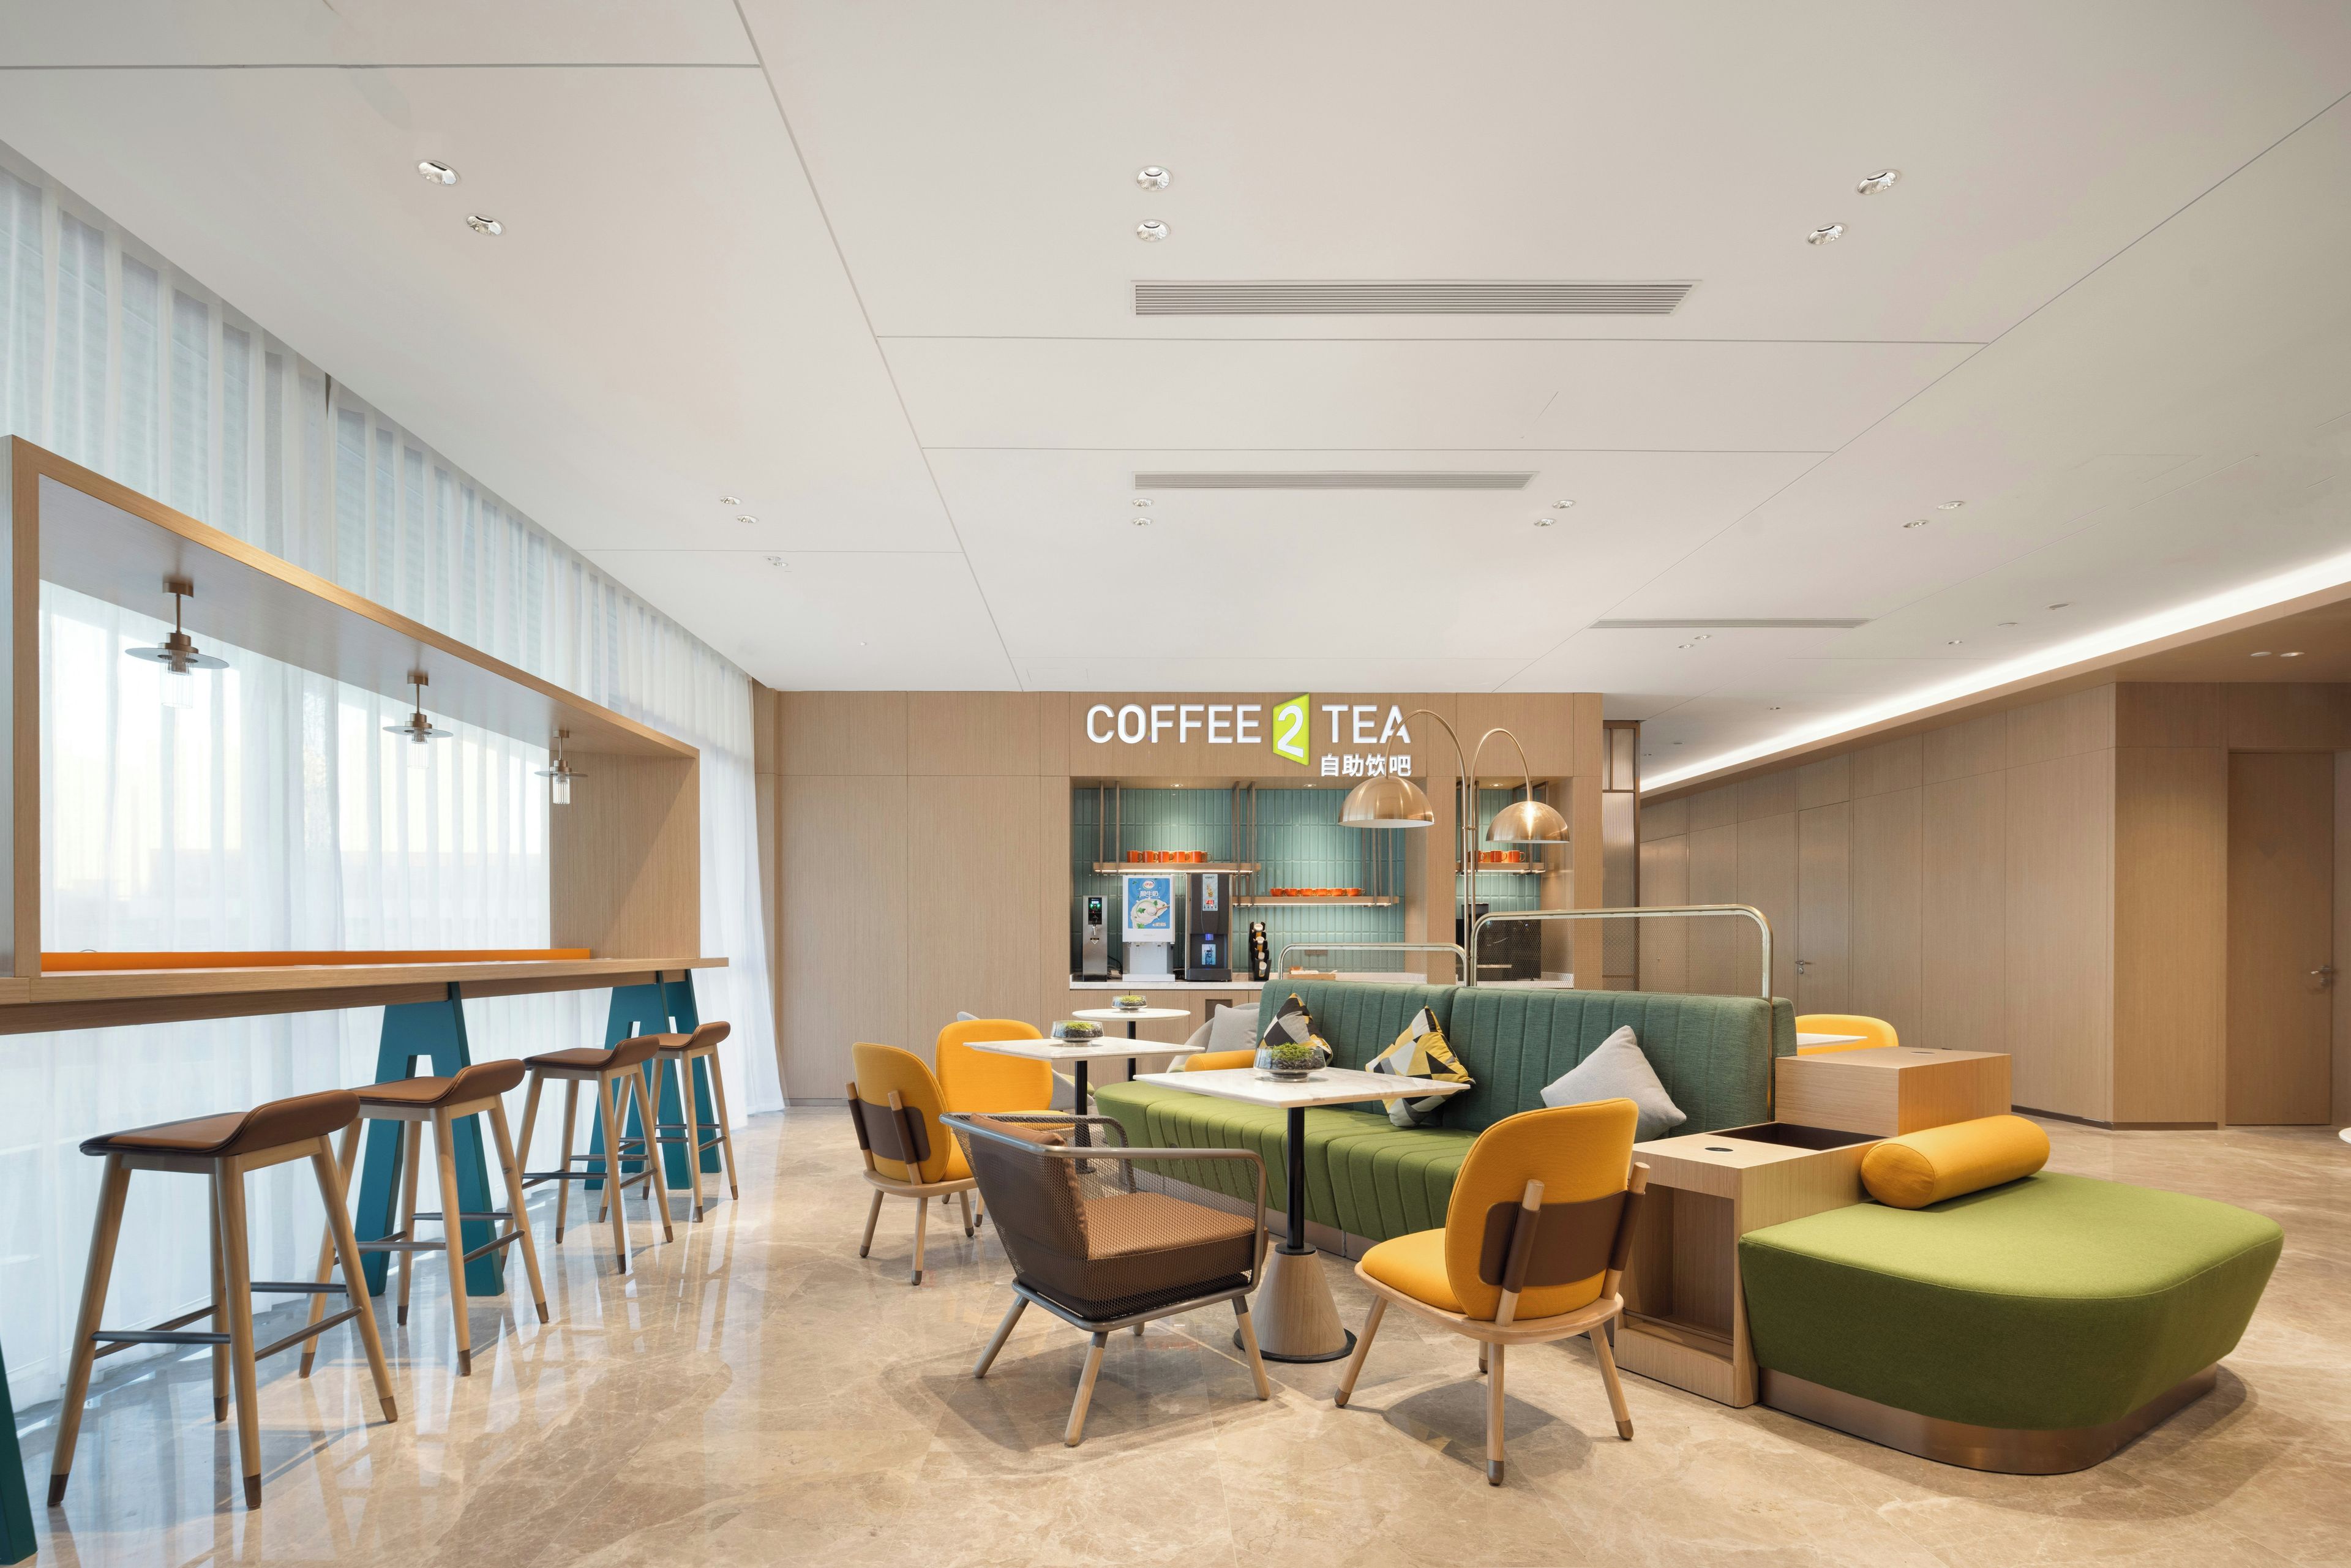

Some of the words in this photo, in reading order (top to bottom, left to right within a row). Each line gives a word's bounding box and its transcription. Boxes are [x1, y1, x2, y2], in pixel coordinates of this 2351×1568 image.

[1087, 704, 1262, 744] COFFEE
[1277, 705, 1303, 758] 2
[1321, 705, 1411, 744] TEA
[1321, 753, 1412, 777] 自助饮吧
